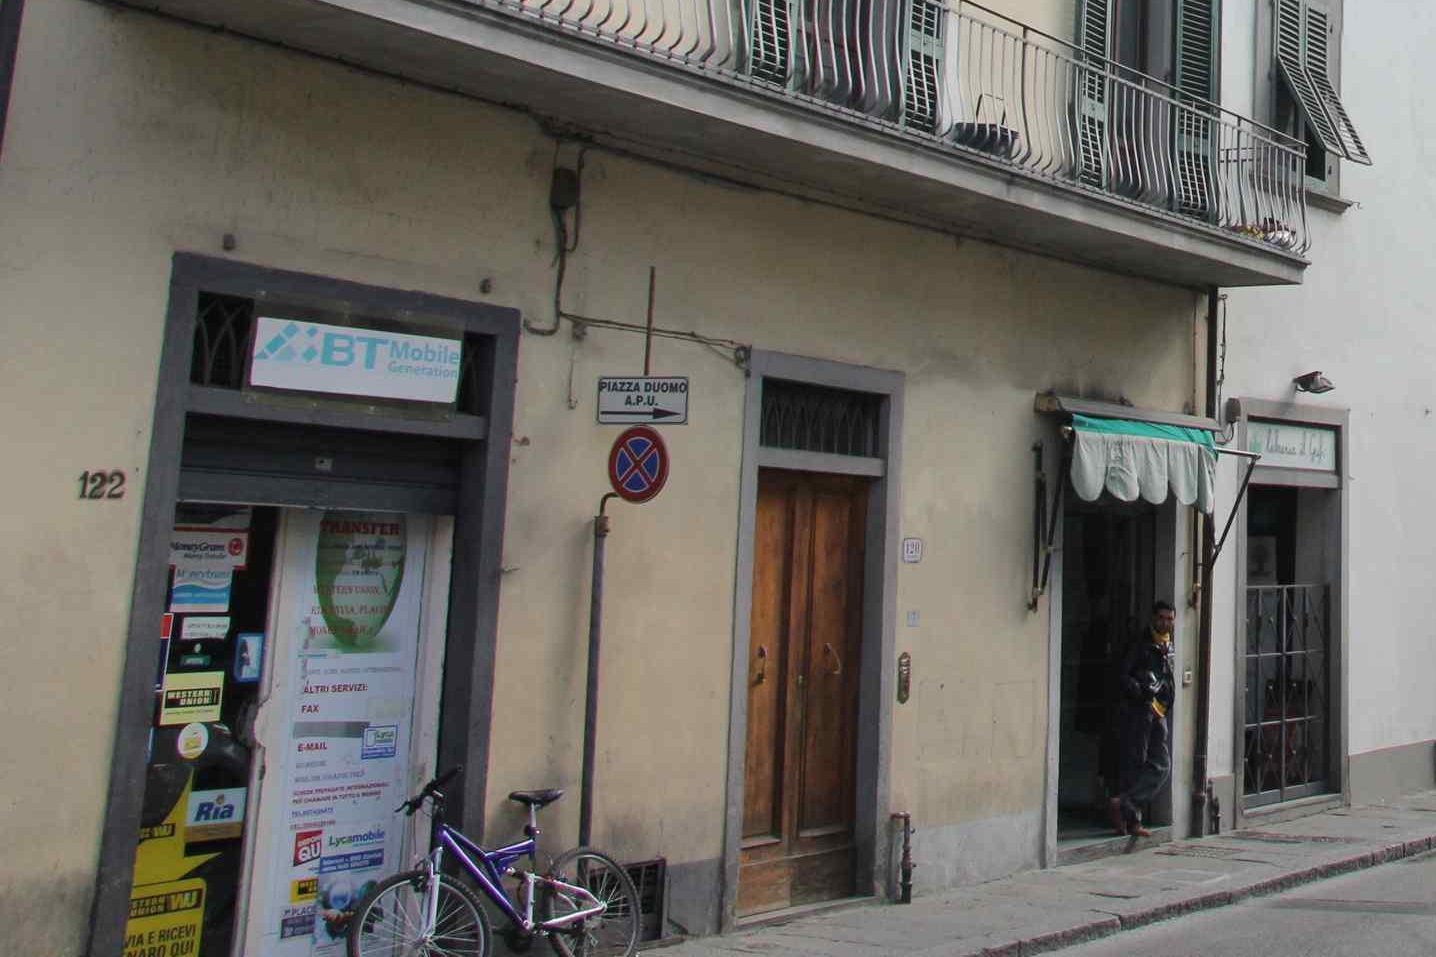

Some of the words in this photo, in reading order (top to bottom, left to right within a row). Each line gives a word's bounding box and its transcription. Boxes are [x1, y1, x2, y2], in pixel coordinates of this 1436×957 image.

[321, 332, 391, 371] BT
[389, 342, 459, 365] Mobile
[387, 361, 459, 379] Generation
[599, 381, 640, 393] PIAZZA
[644, 382, 688, 393] DUOMO
[624, 395, 659, 406] A.P.U.
[78, 470, 126, 500] 122
[167, 689, 211, 700] WESTERN
[303, 684, 329, 695] ALTRI
[180, 696, 209, 706] UNION
[301, 704, 319, 714] FAX
[195, 798, 235, 821] Ria
[329, 829, 385, 847] Lycamobile
[148, 931, 157, 944] E
[159, 923, 196, 942] RICEVI
[171, 938, 194, 956] QUI
